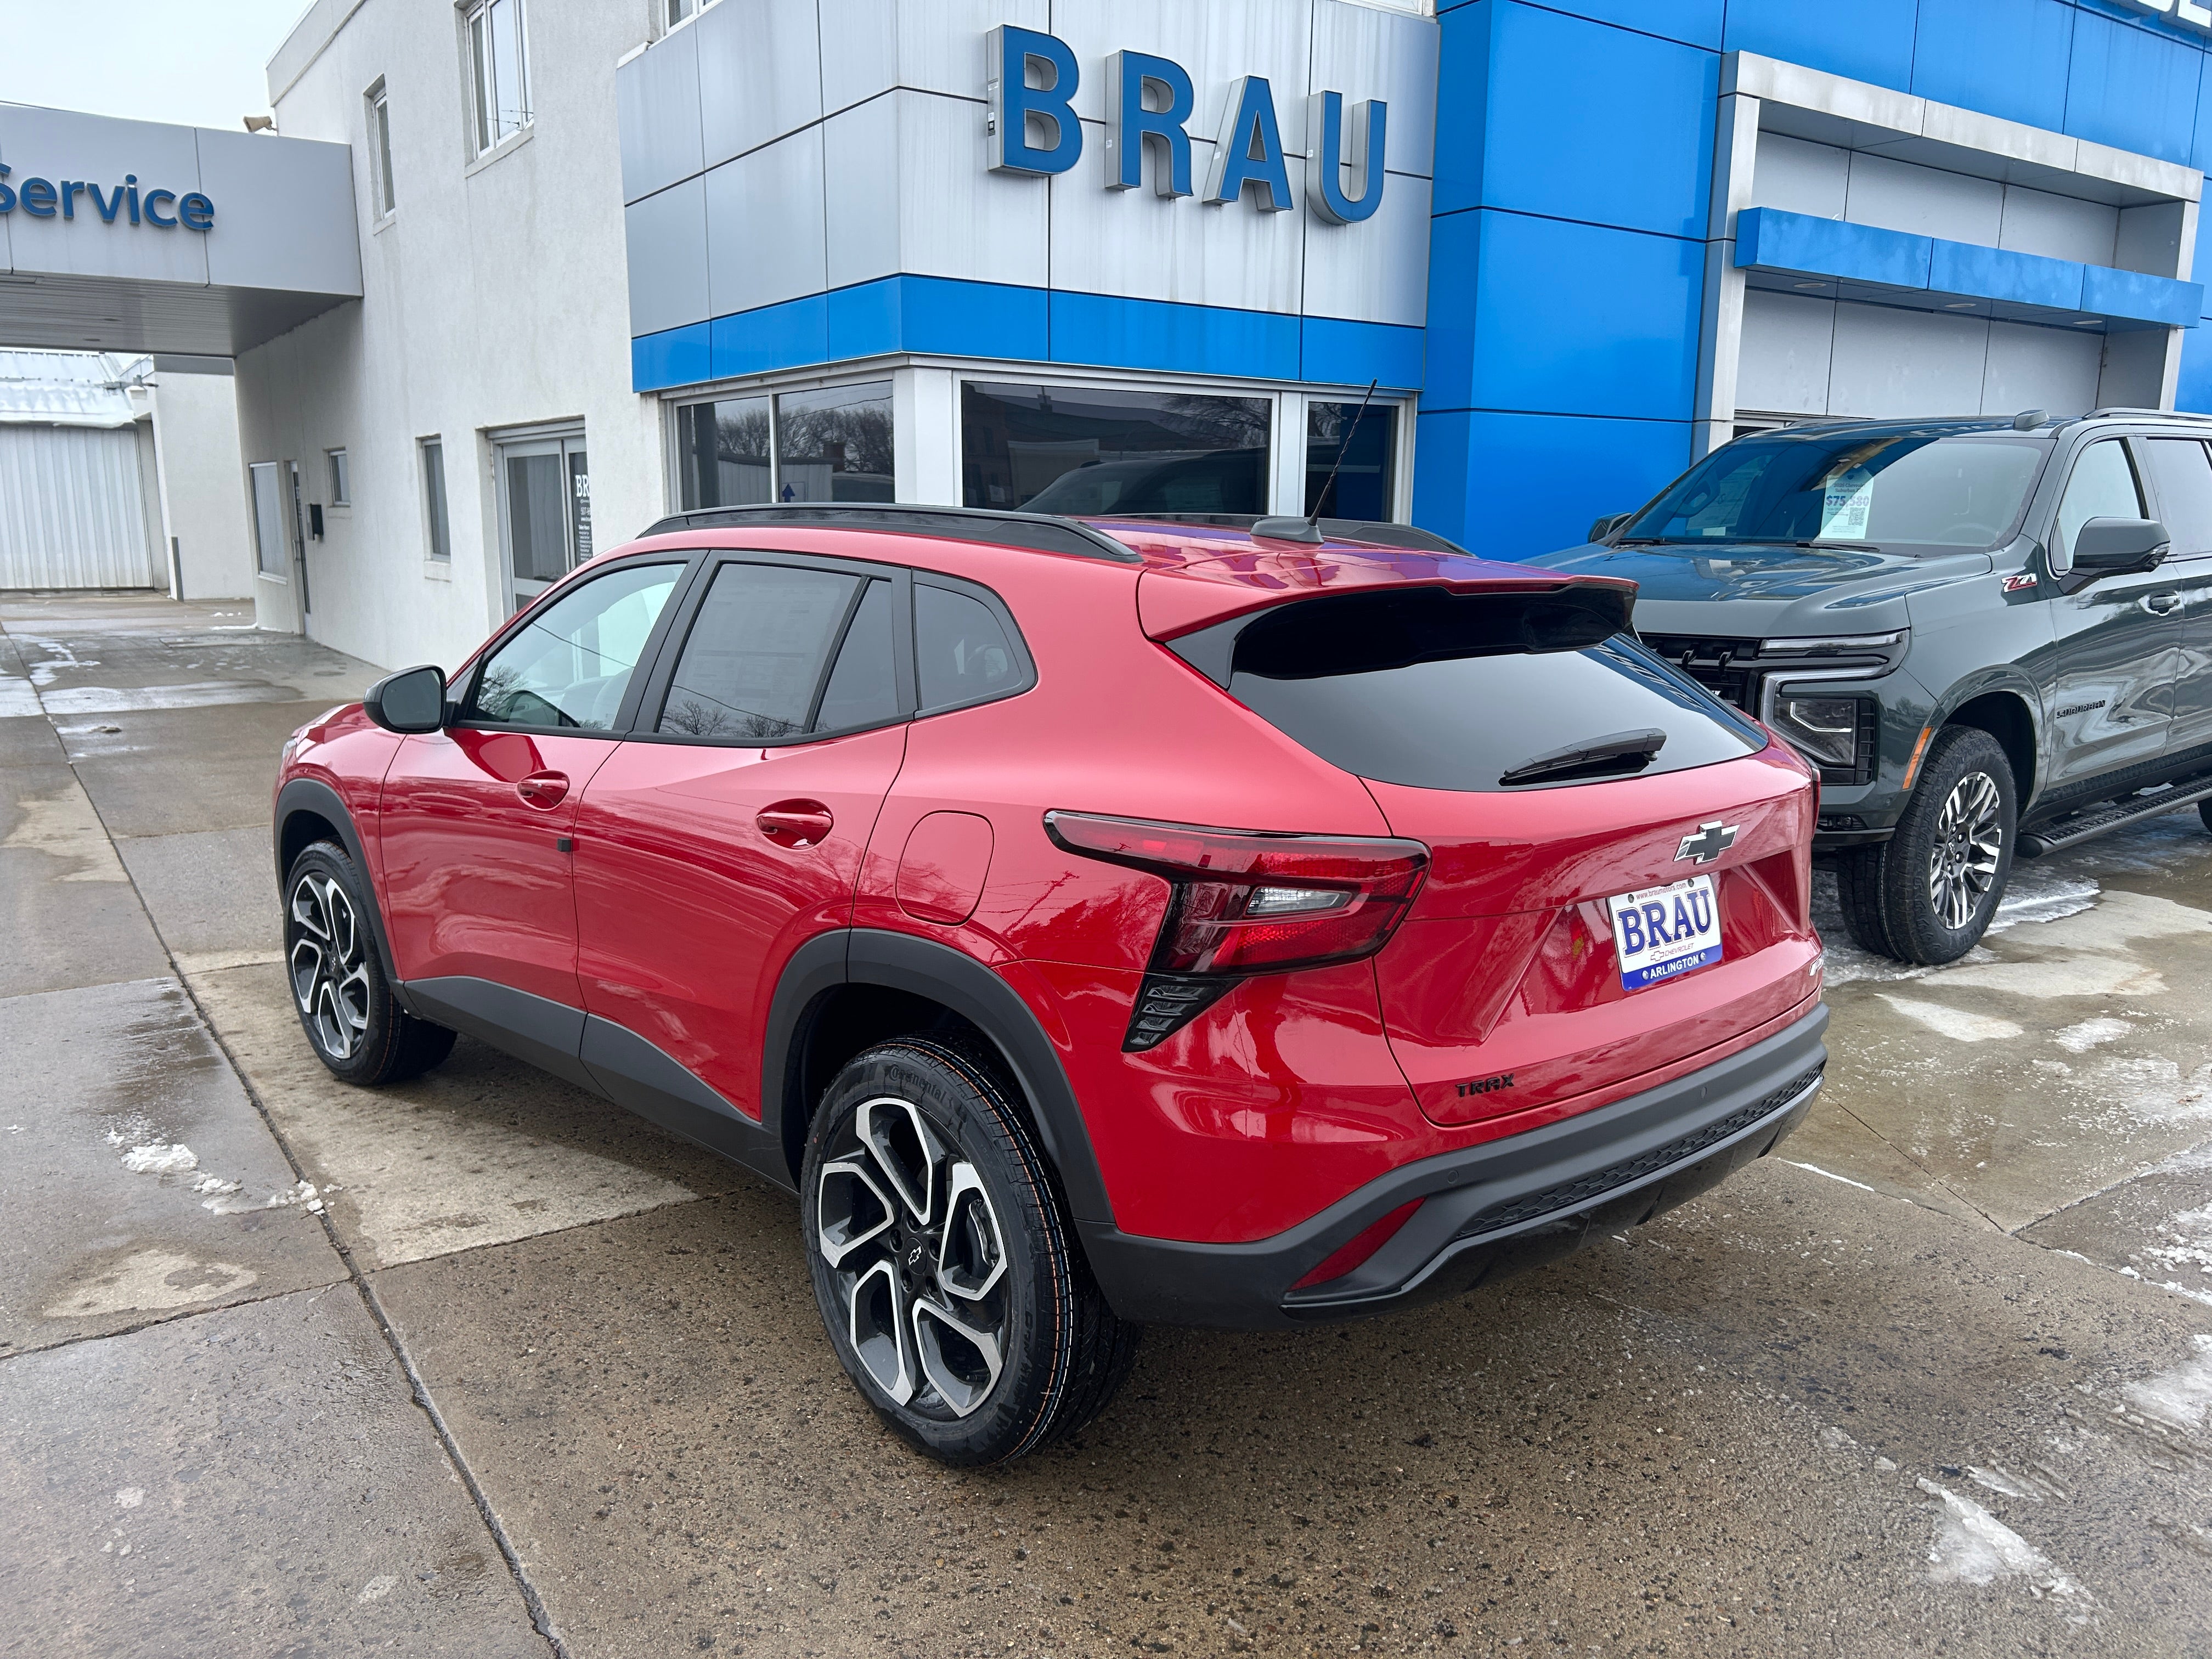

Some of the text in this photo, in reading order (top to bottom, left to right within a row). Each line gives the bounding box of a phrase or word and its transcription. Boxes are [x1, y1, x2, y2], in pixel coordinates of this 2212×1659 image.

[988, 24, 1387, 225] BRAU
[0, 162, 215, 231] Service
[2001, 573, 2037, 592] Z71
[1635, 883, 1686, 899] www.braumotors.com
[1616, 887, 1712, 958] BRAU
[1664, 943, 1694, 956] CHEVROLET
[1650, 955, 1700, 979] ARLINGTON
[1455, 1074, 1514, 1097] TRAX
